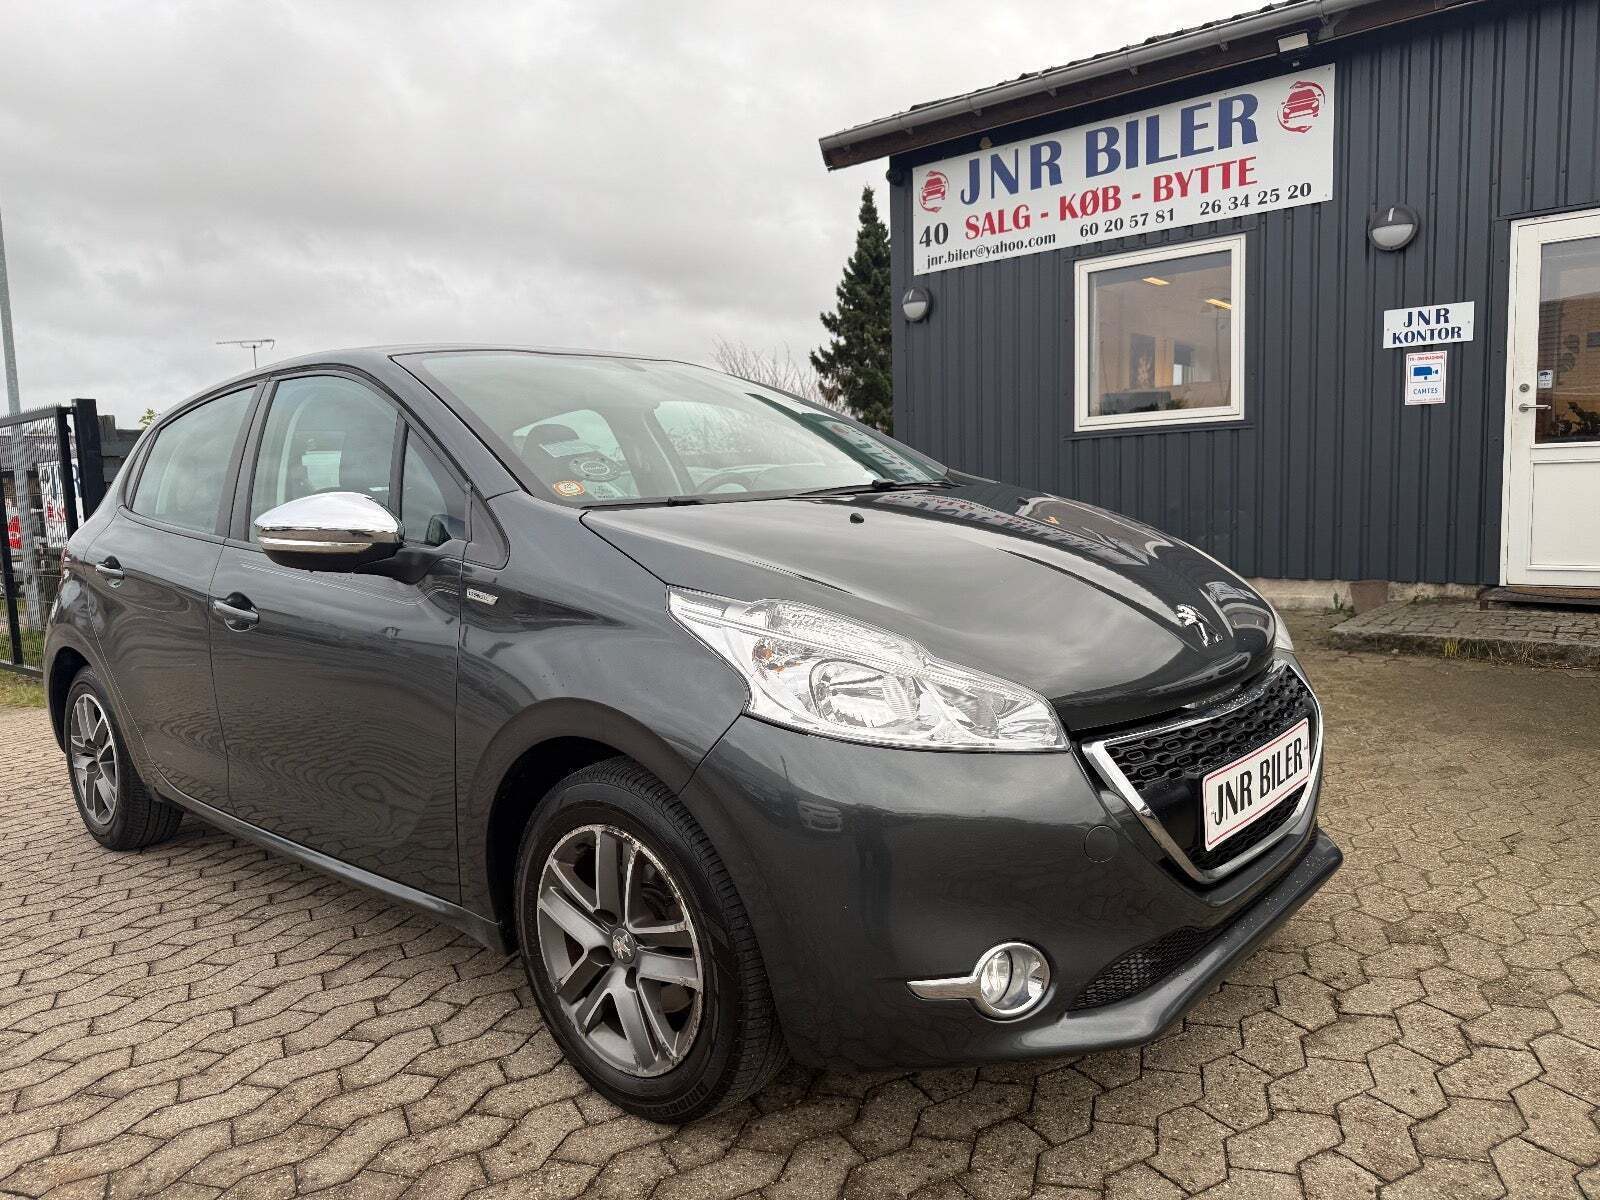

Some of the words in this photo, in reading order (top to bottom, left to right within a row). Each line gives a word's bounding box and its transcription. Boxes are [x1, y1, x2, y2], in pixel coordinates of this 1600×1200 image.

[960, 140, 1063, 206] JNR
[1085, 93, 1259, 179] BILER
[965, 204, 1031, 240] SALG
[1059, 185, 1122, 222] KØB
[1153, 156, 1258, 203] BYTTE
[1200, 200, 1222, 216] 26
[1228, 194, 1250, 211] 34
[1257, 188, 1280, 206] 25
[1287, 182, 1312, 200] 20
[919, 222, 949, 248] 40
[1079, 222, 1099, 238] 60
[1104, 216, 1124, 233] 20
[1129, 212, 1149, 229] 57
[1155, 207, 1174, 224] 81
[927, 233, 1056, 269] jnr.biler@yahoo.com
[1403, 307, 1450, 328] JNR
[1392, 326, 1462, 345] KONTOR
[1213, 770, 1253, 826] JNR
[1259, 737, 1303, 799] BILER
